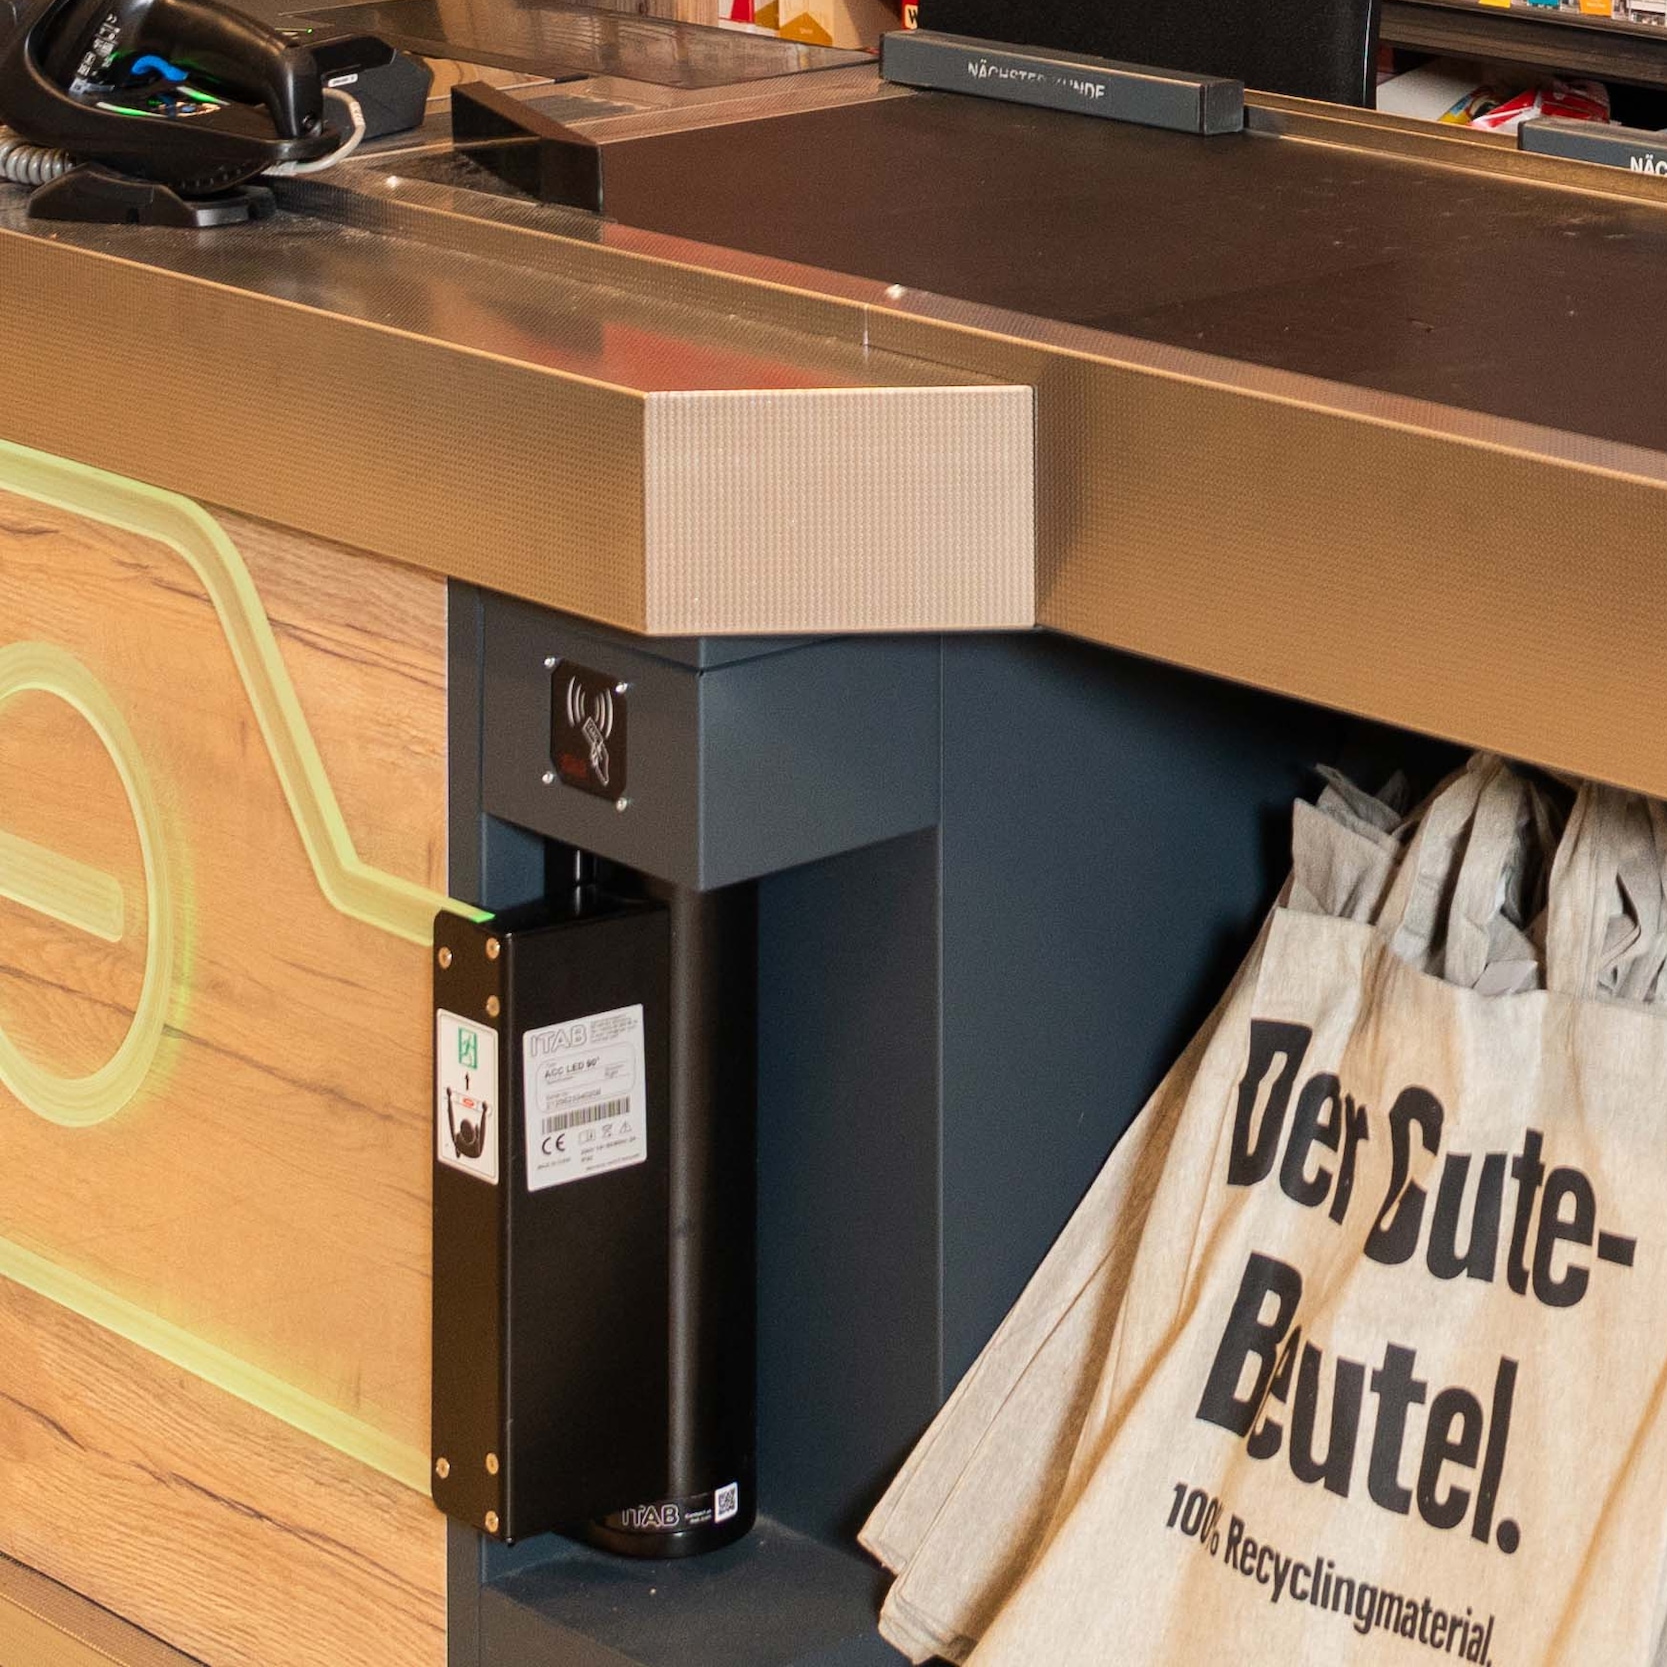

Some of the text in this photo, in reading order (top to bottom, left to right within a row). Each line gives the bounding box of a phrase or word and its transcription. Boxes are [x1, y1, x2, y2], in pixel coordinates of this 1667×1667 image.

[530, 1022, 587, 1058] ITAB
[1227, 1019, 1368, 1225] Der
[1195, 1252, 1521, 1555] Beutel.
[1167, 1481, 1493, 1667] 100% Recyclingmaterial.
